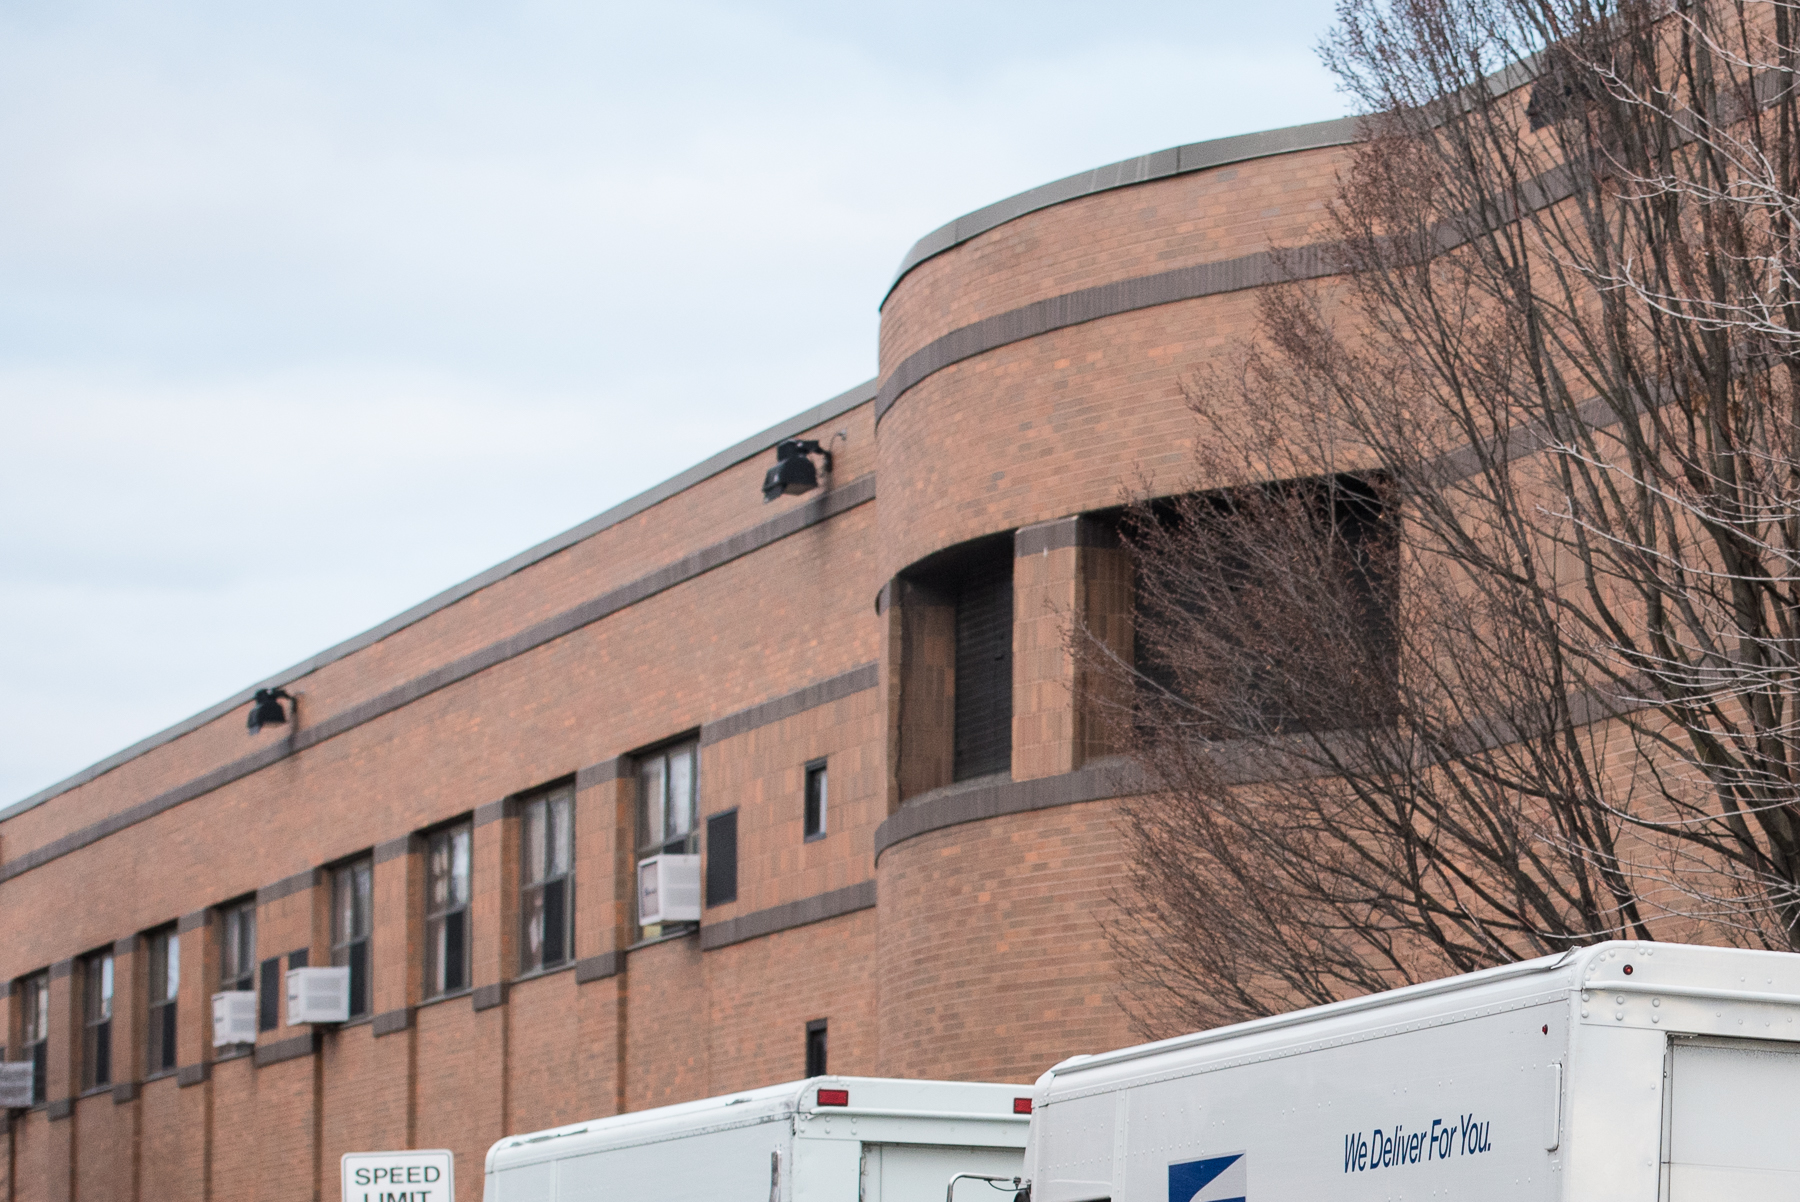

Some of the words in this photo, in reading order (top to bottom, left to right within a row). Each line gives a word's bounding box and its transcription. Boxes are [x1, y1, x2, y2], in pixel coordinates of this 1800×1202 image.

[1344, 1131, 1368, 1173] We
[1370, 1125, 1428, 1169] Deliver
[1428, 1118, 1458, 1161] For
[1460, 1113, 1492, 1156] You.
[355, 1165, 441, 1185] SPEED
